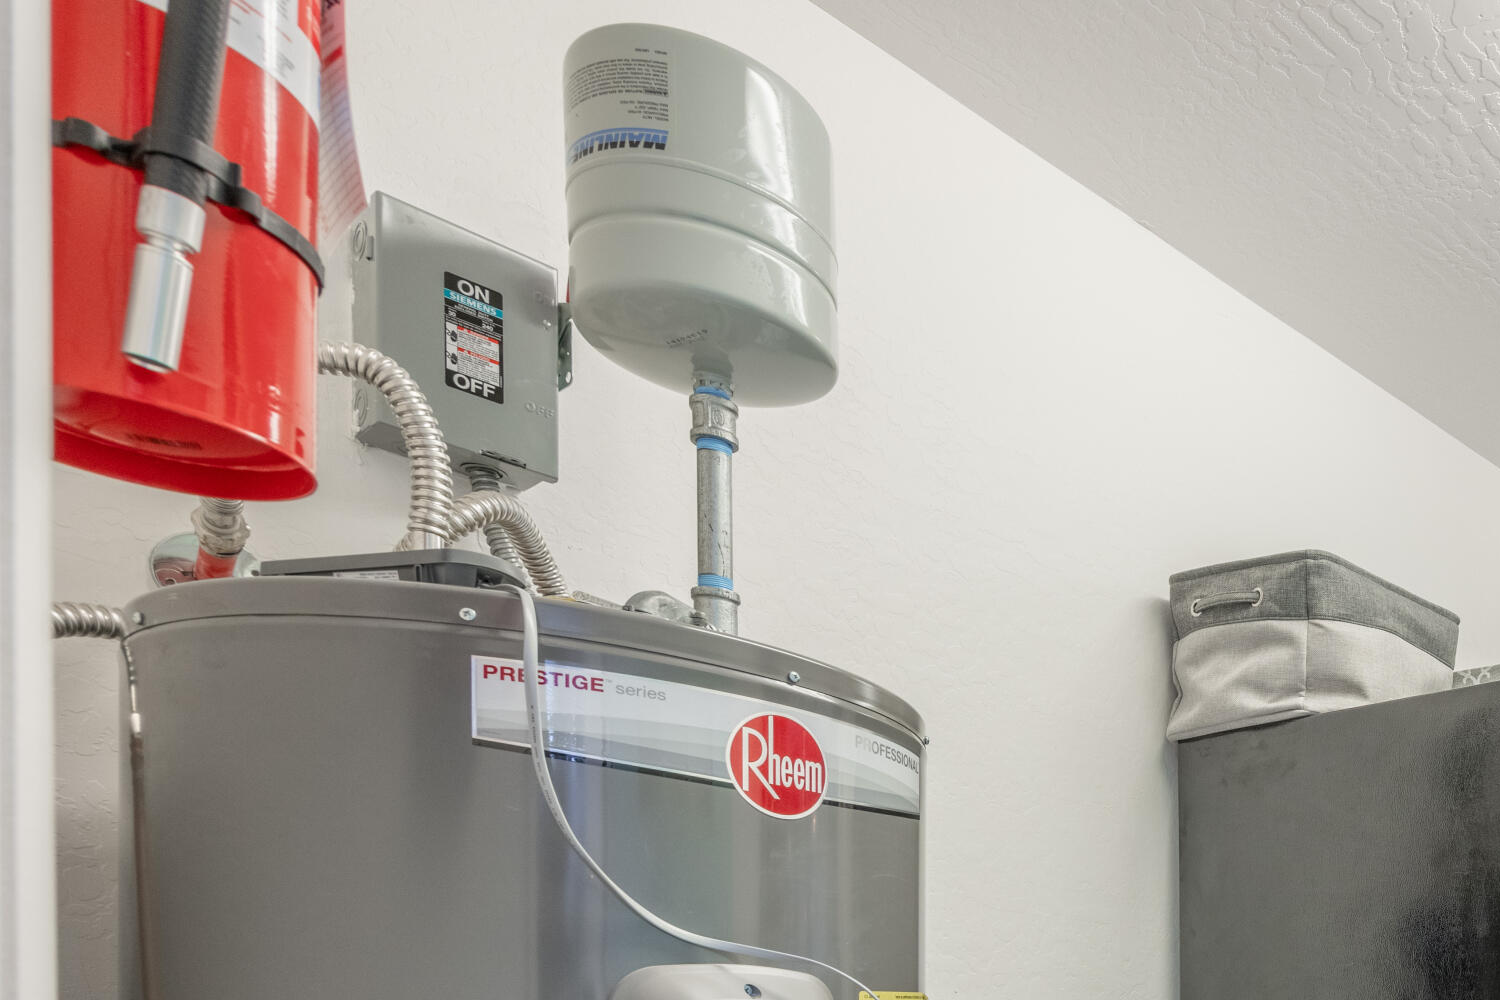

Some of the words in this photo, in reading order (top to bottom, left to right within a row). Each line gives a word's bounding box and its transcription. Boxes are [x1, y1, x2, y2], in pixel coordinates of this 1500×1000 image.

[570, 131, 668, 164] MAINLINE
[449, 291, 497, 316] SIEMENS
[457, 279, 490, 304] ON
[453, 373, 496, 398] OFF
[615, 683, 667, 701] series
[742, 715, 823, 801] Rheem
[855, 734, 919, 775] PROFESSIONAL
